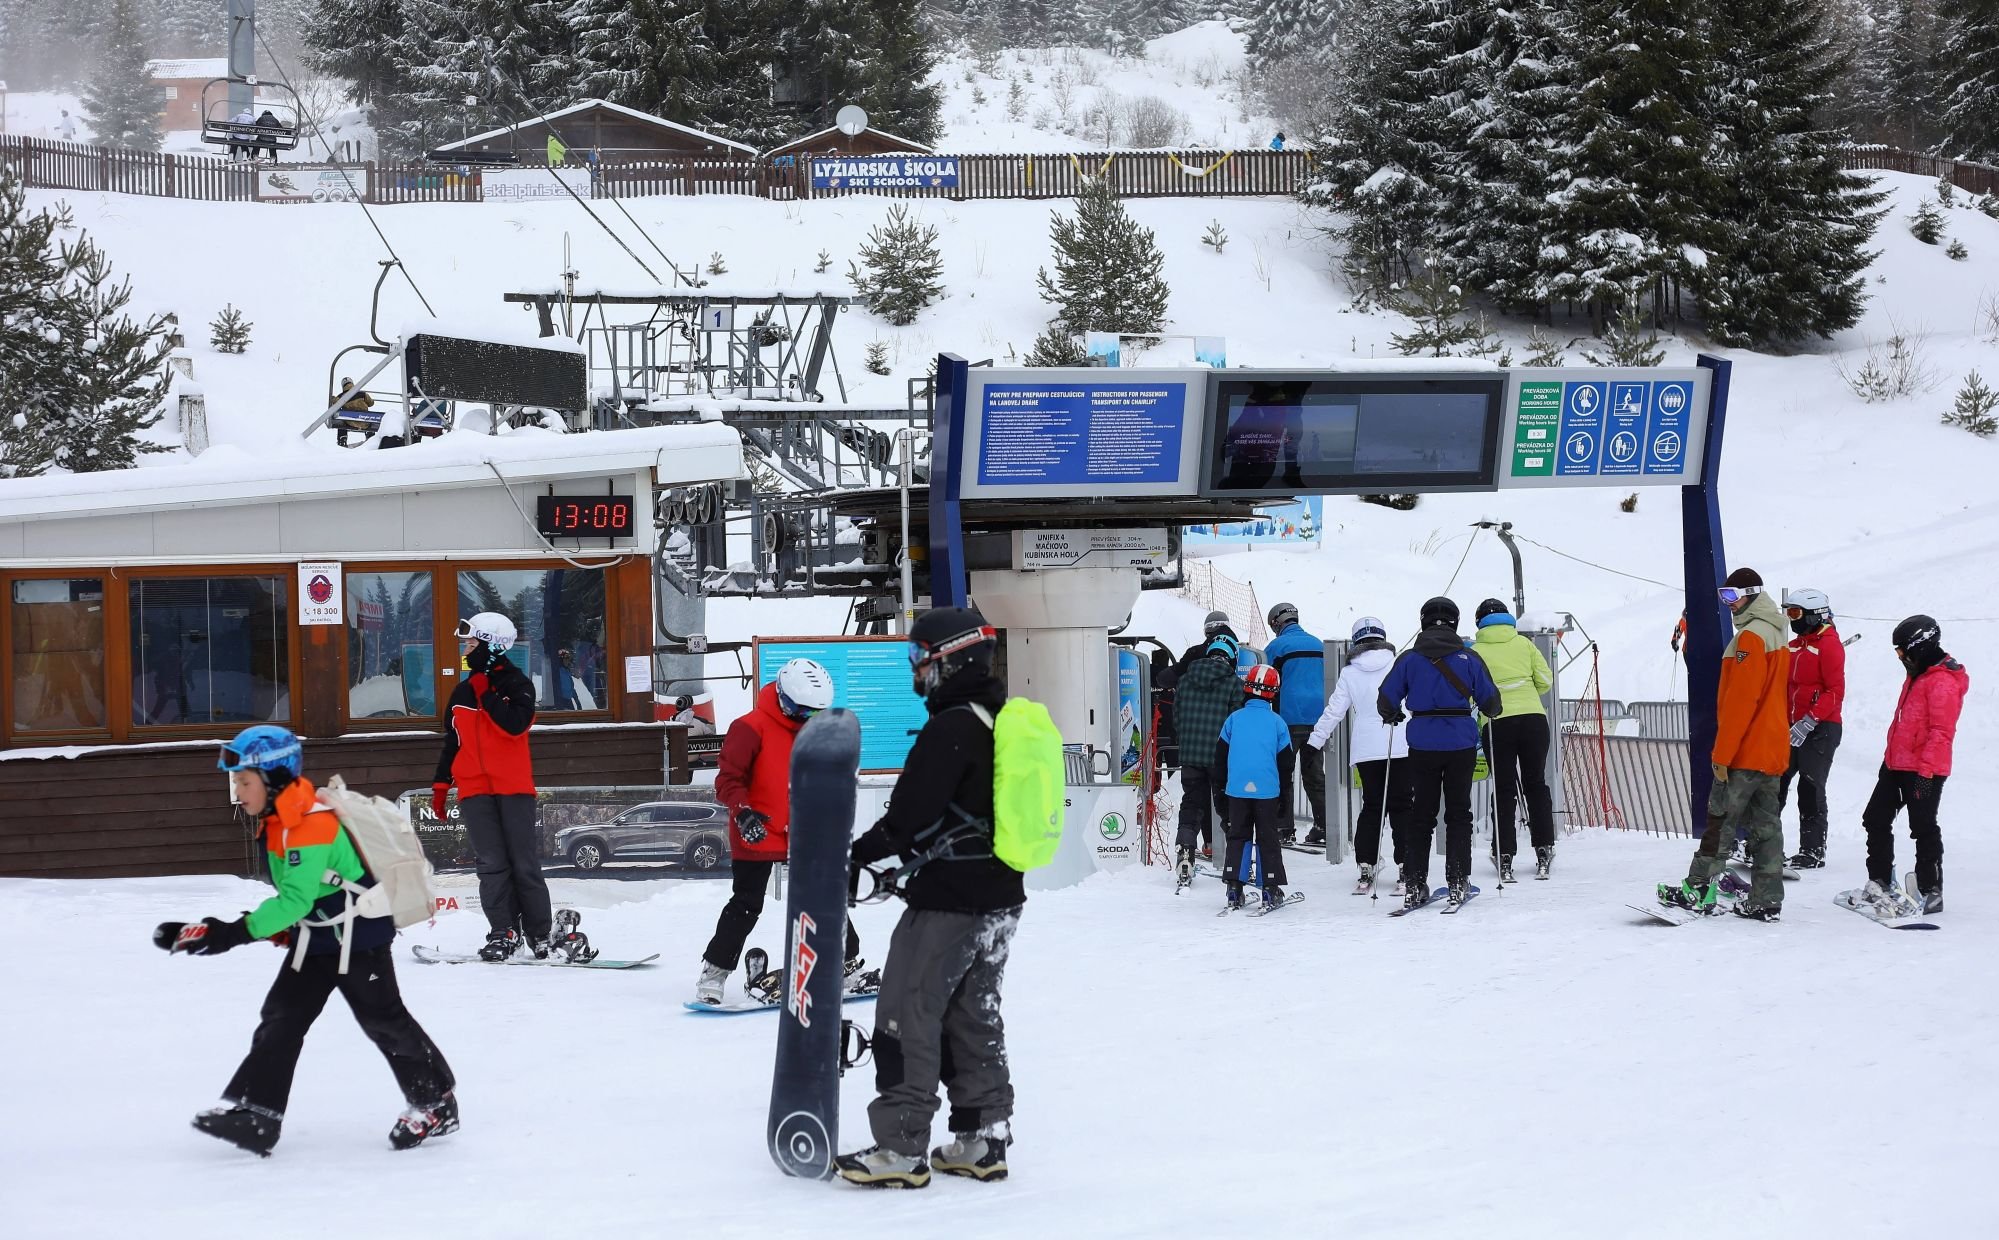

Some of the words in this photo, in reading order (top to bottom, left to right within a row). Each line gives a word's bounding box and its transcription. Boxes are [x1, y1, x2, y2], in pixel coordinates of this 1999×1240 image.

[814, 159, 900, 177] LYŽIARSKA
[903, 158, 956, 176] ŠKOLA
[848, 177, 869, 186] SKI
[873, 177, 922, 186] SCHOOL
[714, 310, 721, 328] 1
[1050, 390, 1086, 398] CESTUJÚCICH
[1021, 398, 1039, 406] DRÁHE
[554, 504, 627, 528] 13:08
[1035, 541, 1069, 550] MAČKOVO
[1024, 550, 1059, 559] KUBÍNSKA
[312, 607, 322, 615] 18
[323, 607, 338, 615] 300
[693, 640, 701, 649] 58
[1560, 725, 1580, 733] ABIA
[419, 824, 454, 833] Pripravte
[1096, 845, 1130, 853] ŠKODA
